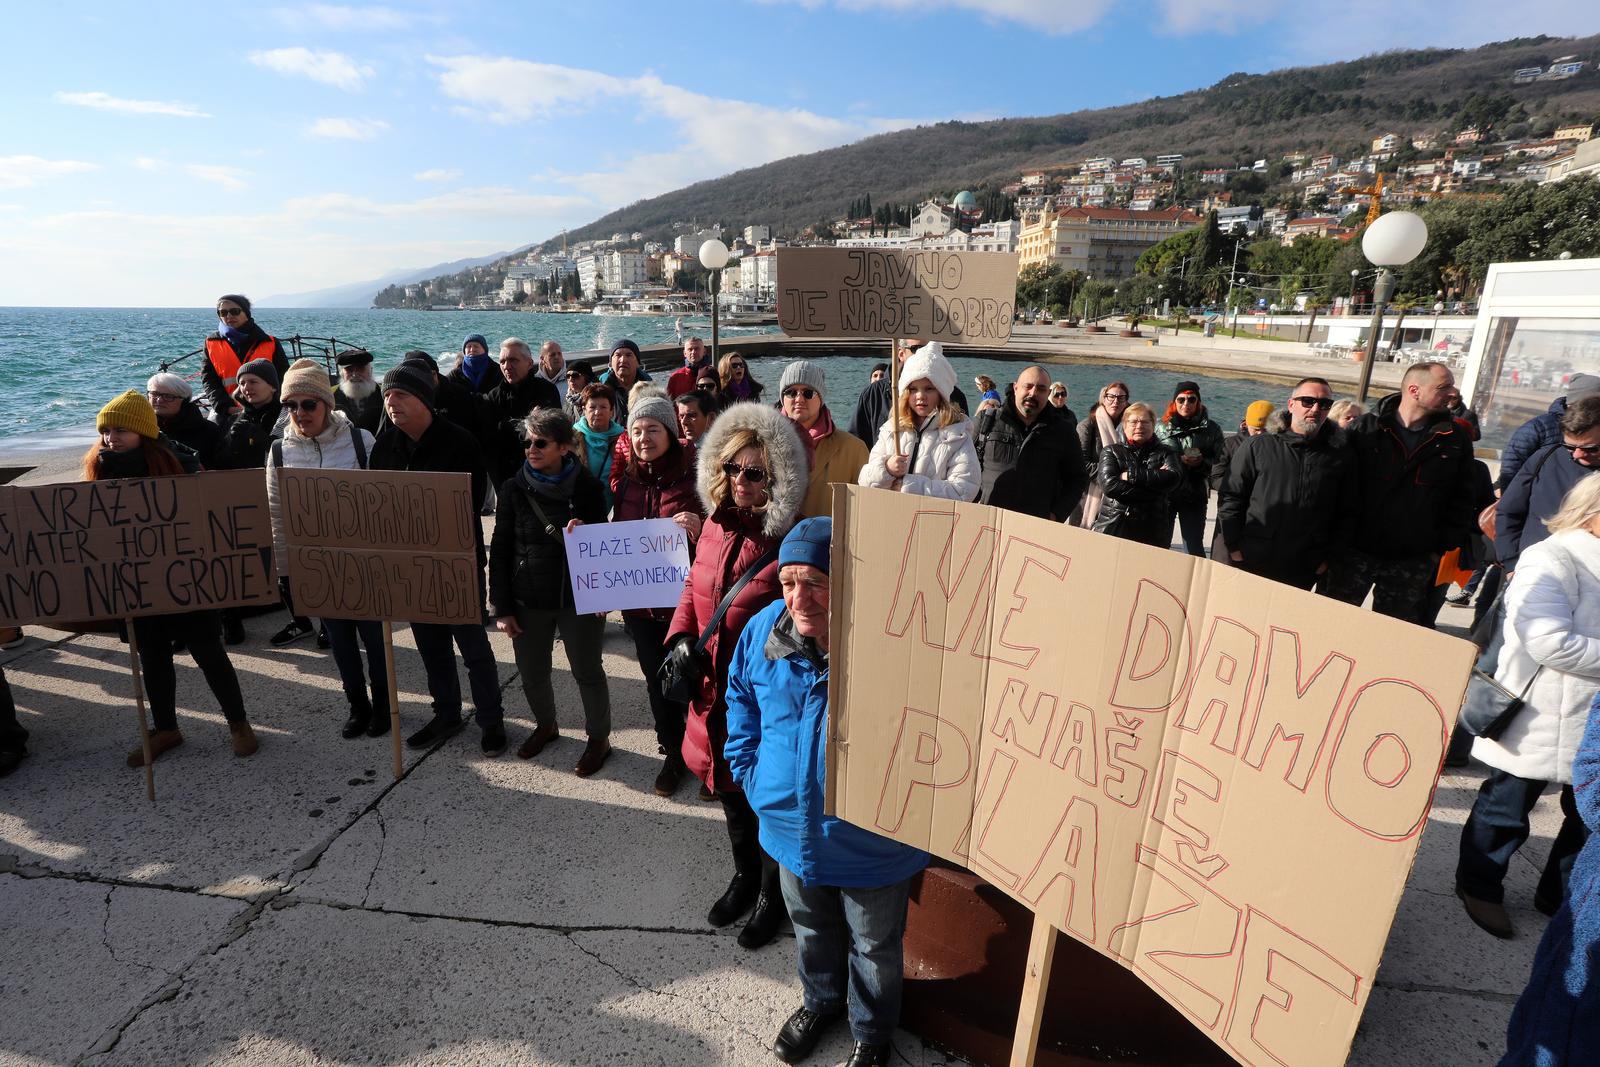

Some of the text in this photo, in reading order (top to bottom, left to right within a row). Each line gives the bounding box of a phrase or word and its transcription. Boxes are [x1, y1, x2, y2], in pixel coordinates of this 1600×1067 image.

[844, 251, 963, 290] JAVNO
[783, 287, 1013, 339] JE NAŠE DOBRO
[30, 479, 178, 531] VRAŽJU
[453, 489, 475, 548] U
[0, 505, 259, 568] MATER HOTE, NE
[578, 533, 688, 559] PLAŽE SVIMA
[84, 558, 153, 617] NAŠE
[166, 546, 273, 606] GROTE!
[298, 545, 392, 617] SVOJA
[576, 572, 599, 590] NE
[603, 569, 644, 588] SAMO
[885, 510, 1450, 842] NE DAMO
[991, 679, 1223, 851] NAŠE
